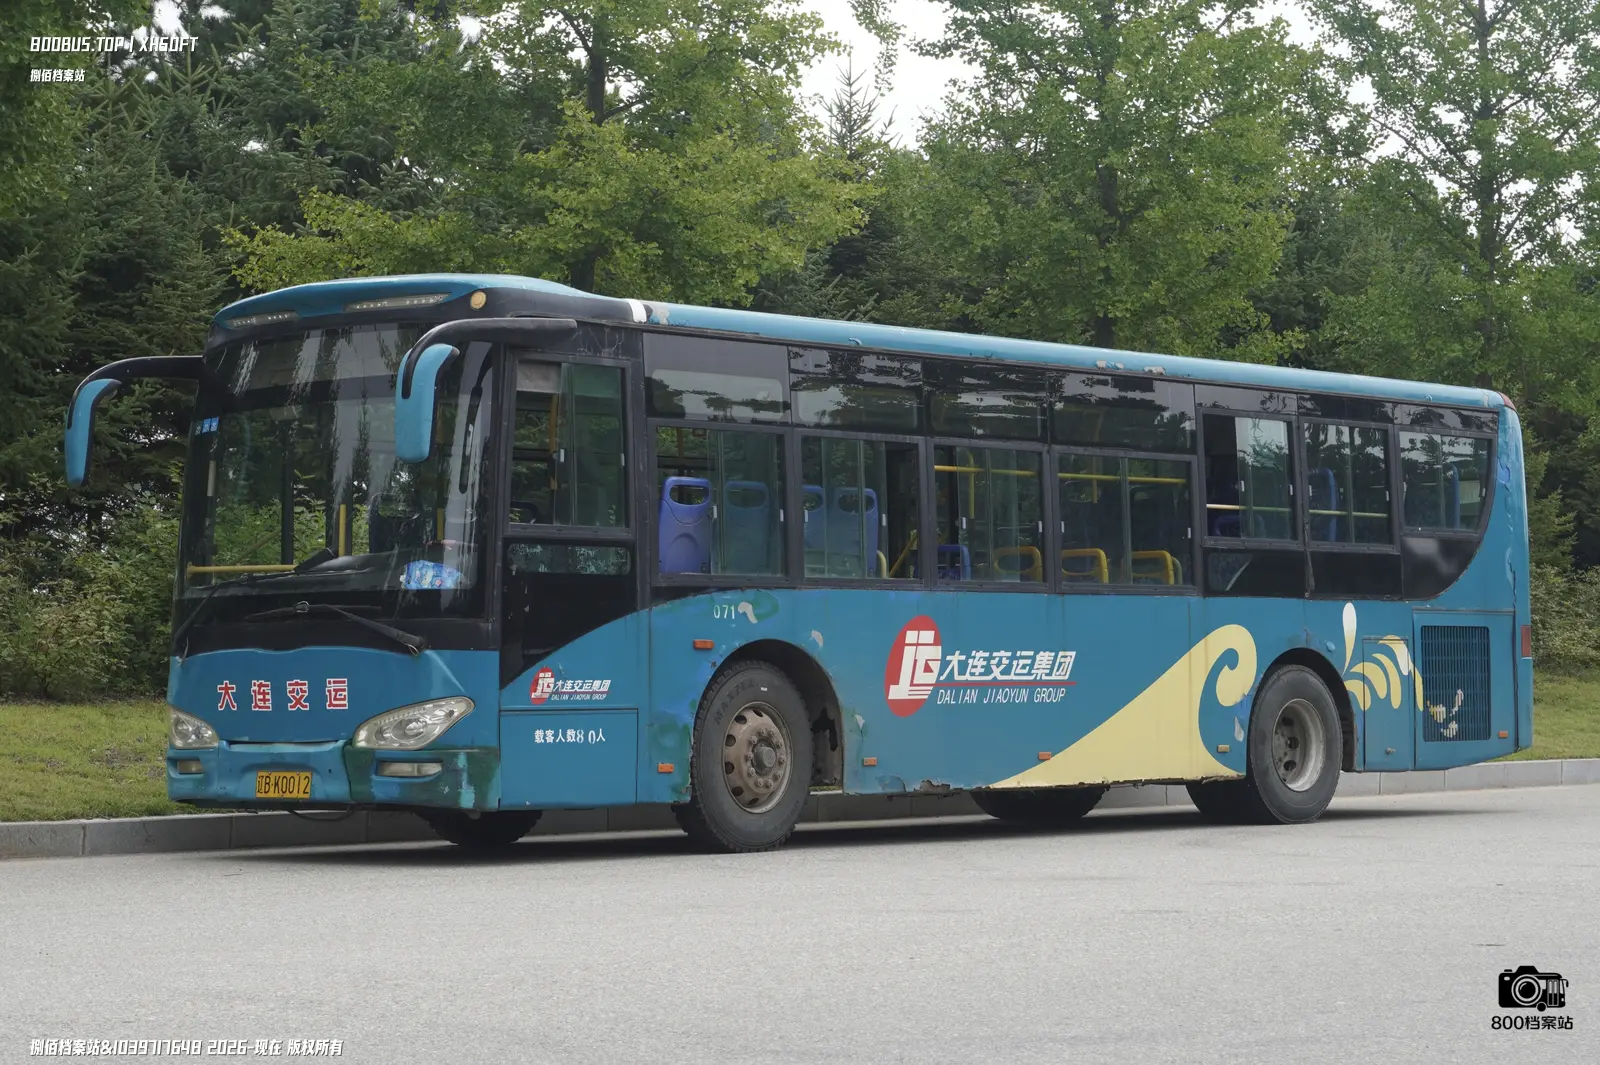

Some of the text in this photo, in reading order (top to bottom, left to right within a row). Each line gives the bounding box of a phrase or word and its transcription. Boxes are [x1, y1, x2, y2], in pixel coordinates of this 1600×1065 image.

[713, 604, 736, 620] 071
[939, 649, 1078, 682] 大连交运集团
[552, 679, 612, 692] 大连交运集团
[216, 677, 350, 712] 大连交运
[551, 692, 607, 701] DALIAN JIAOYUN GROUP
[936, 686, 1067, 705] DALIAN JIAOYUN GROUP
